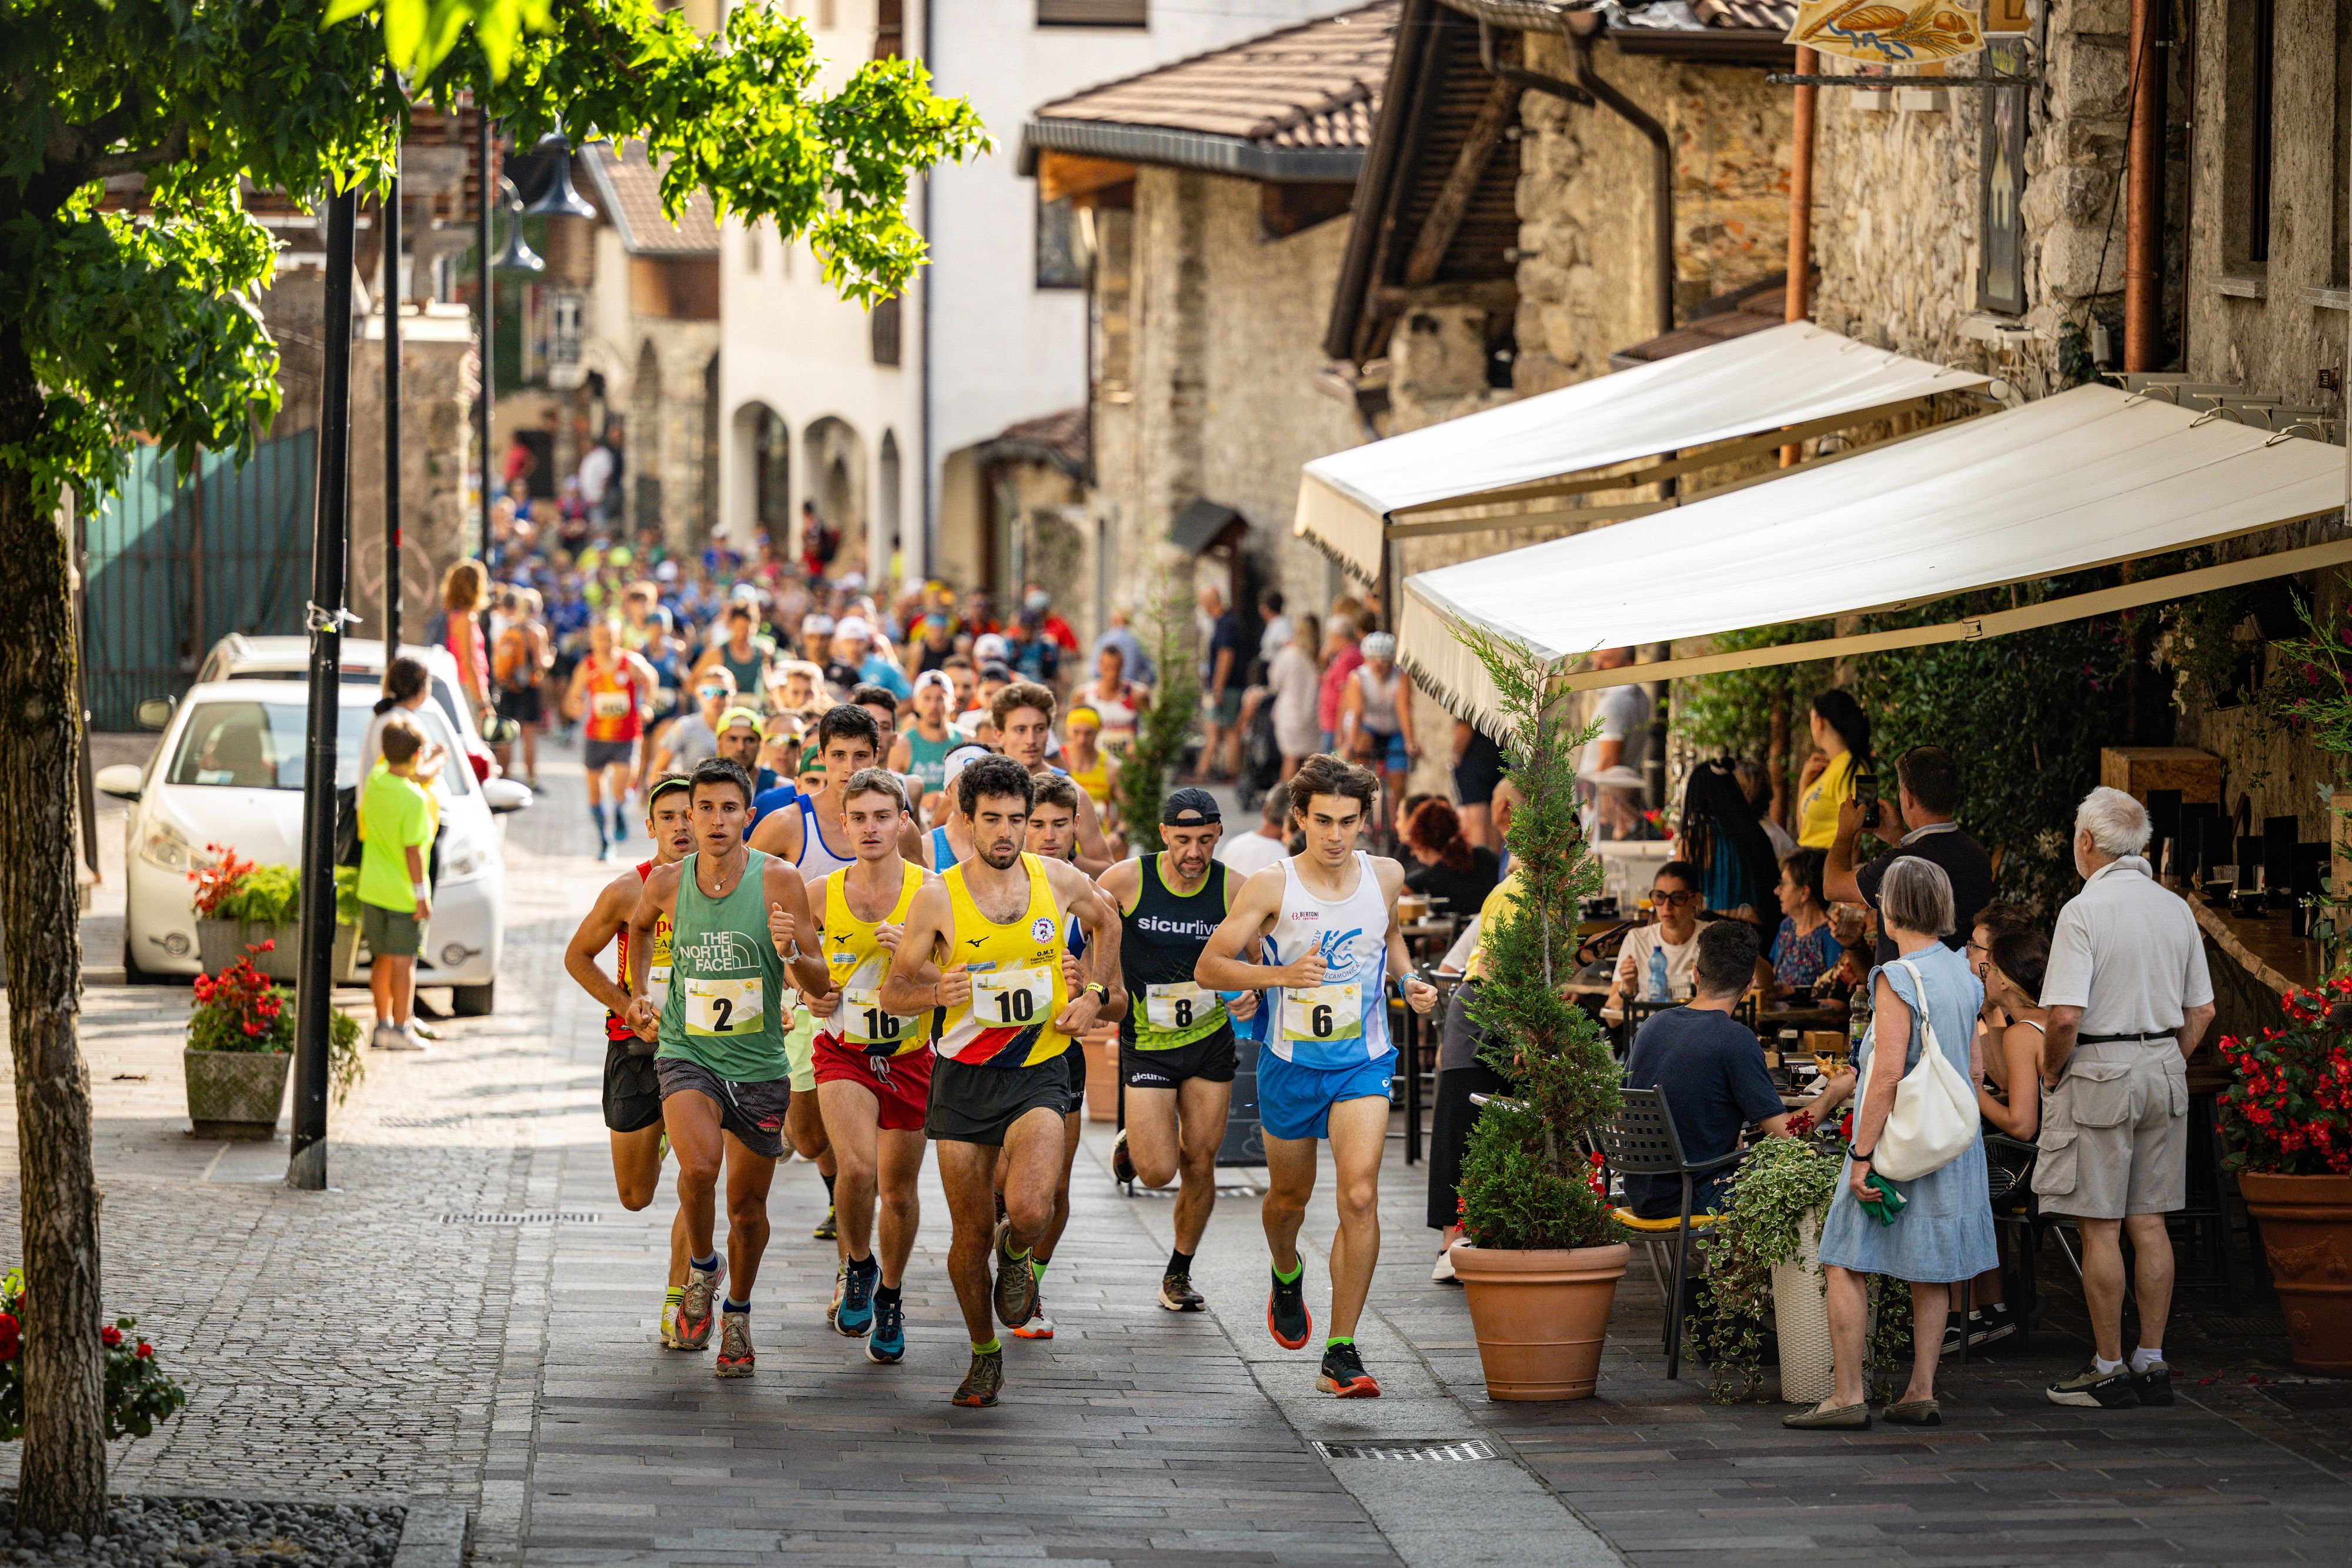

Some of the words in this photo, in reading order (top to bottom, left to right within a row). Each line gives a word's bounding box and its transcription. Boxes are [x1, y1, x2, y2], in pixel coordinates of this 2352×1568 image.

[1037, 918, 1055, 932] BREMBANA
[700, 931, 730, 945] THE
[1036, 935, 1054, 944] ATLETICA
[679, 944, 731, 959] NORTH
[696, 957, 733, 971] FACE
[1323, 964, 1360, 979] ECAMONICA
[994, 988, 1034, 1023] 10
[713, 998, 733, 1032] 2
[1175, 999, 1192, 1028] 8
[1312, 1004, 1333, 1038] 6
[863, 1008, 900, 1039] 16
[2096, 1377, 2116, 1388] SCOTT
